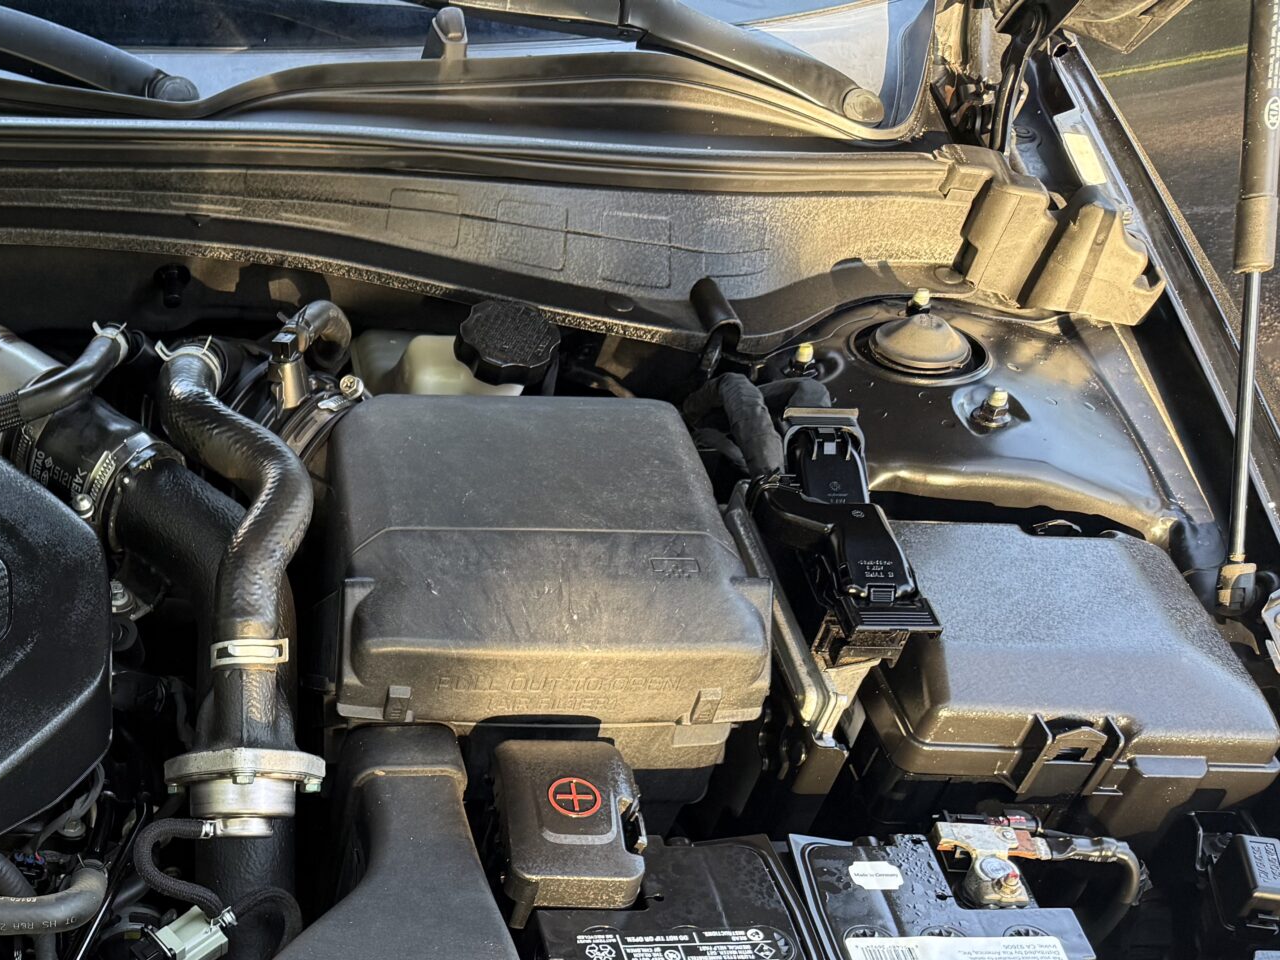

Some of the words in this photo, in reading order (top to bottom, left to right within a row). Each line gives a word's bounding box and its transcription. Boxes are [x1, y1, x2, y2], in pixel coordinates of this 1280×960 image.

[434, 675, 502, 692] PULL
[508, 675, 562, 692] OUT
[571, 675, 603, 692] TO
[605, 675, 681, 692] OPEN
